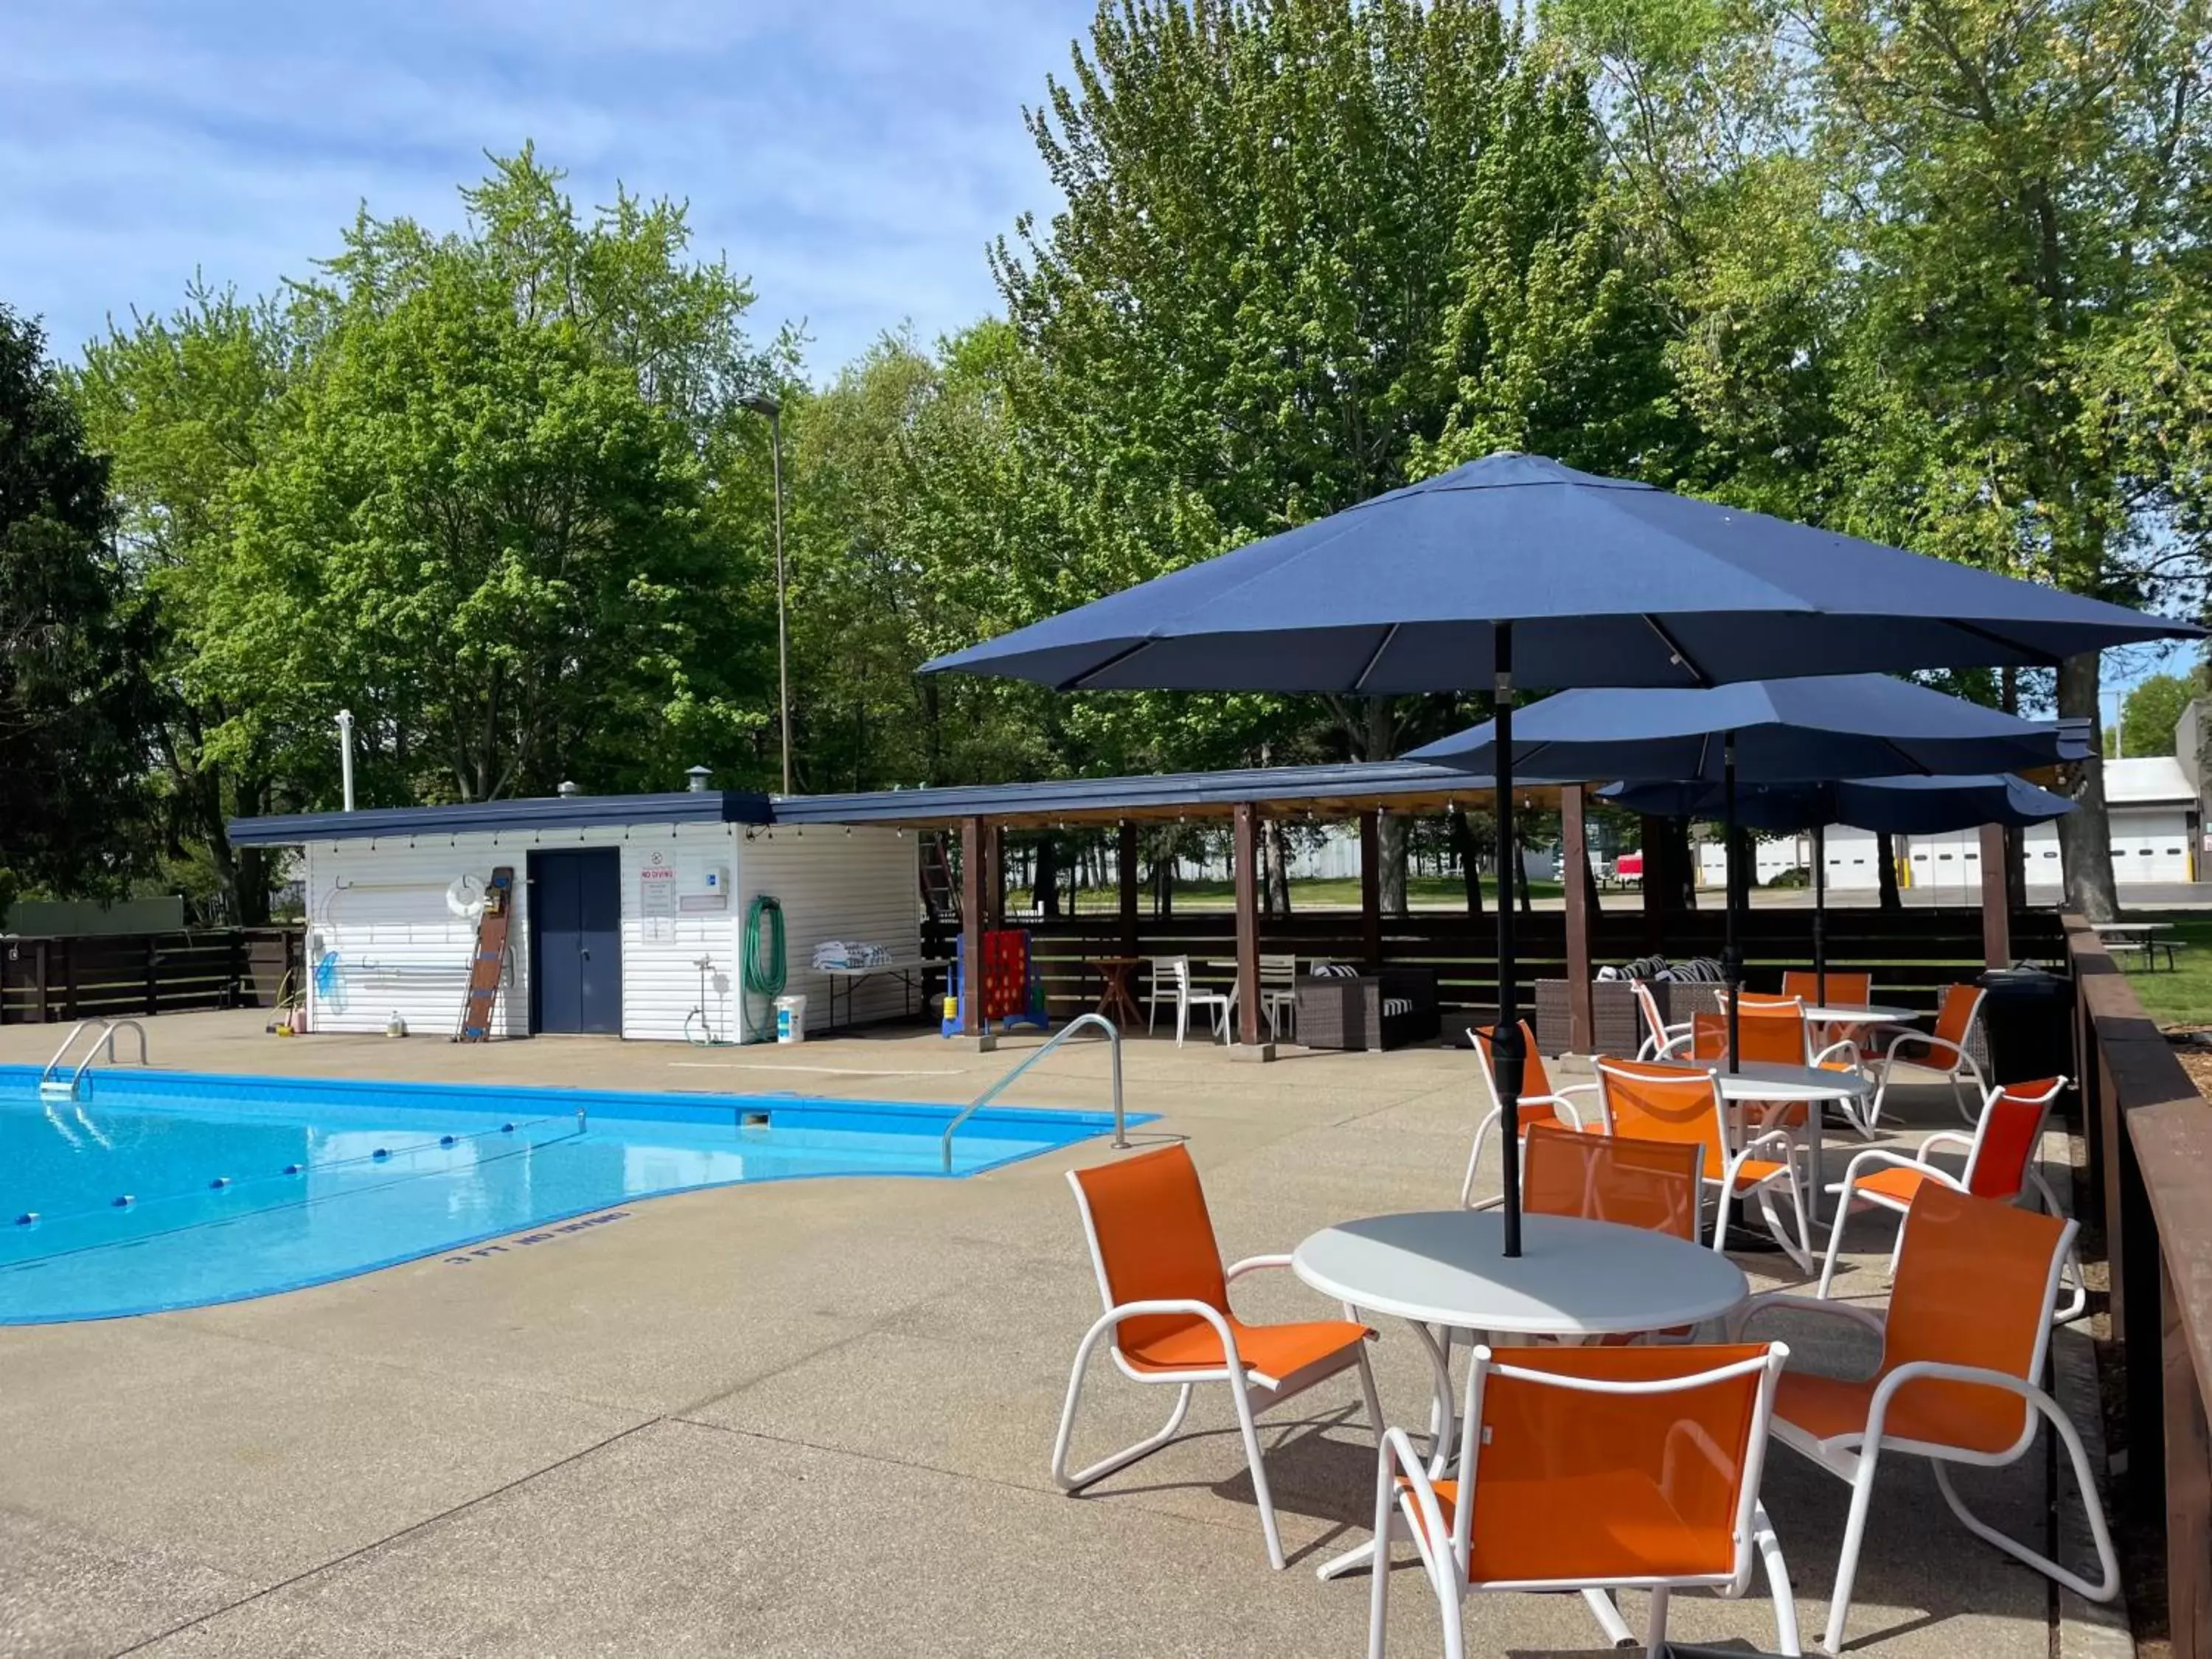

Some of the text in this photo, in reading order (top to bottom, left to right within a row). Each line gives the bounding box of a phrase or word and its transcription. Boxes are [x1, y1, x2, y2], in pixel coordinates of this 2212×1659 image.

[443, 1256, 472, 1265] 3
[469, 1245, 509, 1256] FT
[512, 1232, 555, 1245] NO
